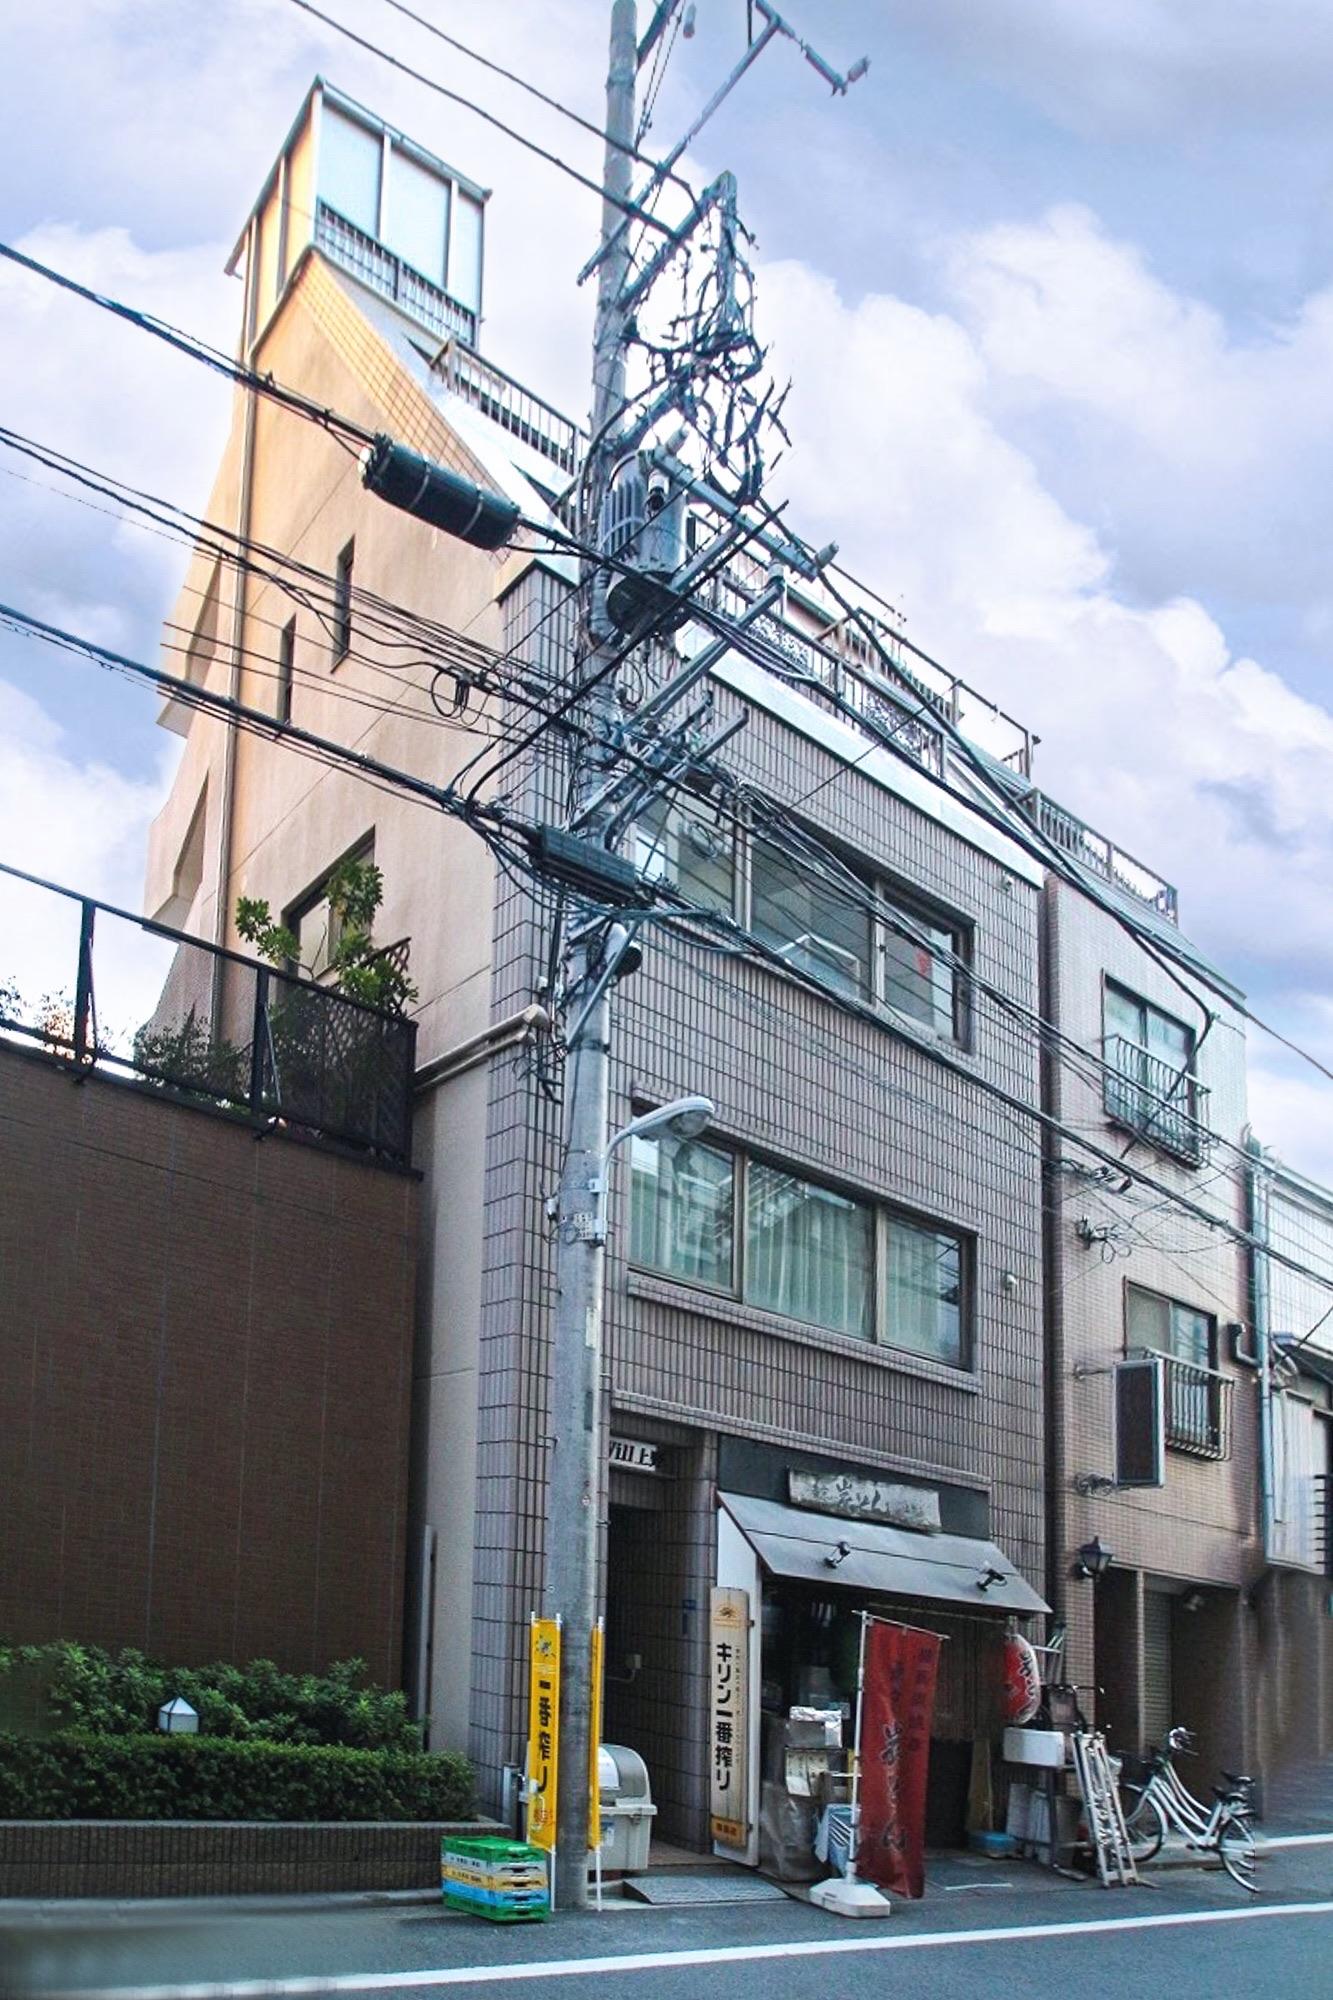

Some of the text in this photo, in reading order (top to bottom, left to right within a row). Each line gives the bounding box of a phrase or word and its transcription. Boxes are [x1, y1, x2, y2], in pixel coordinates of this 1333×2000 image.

[715, 1642, 733, 1790] キリン一番搾り
